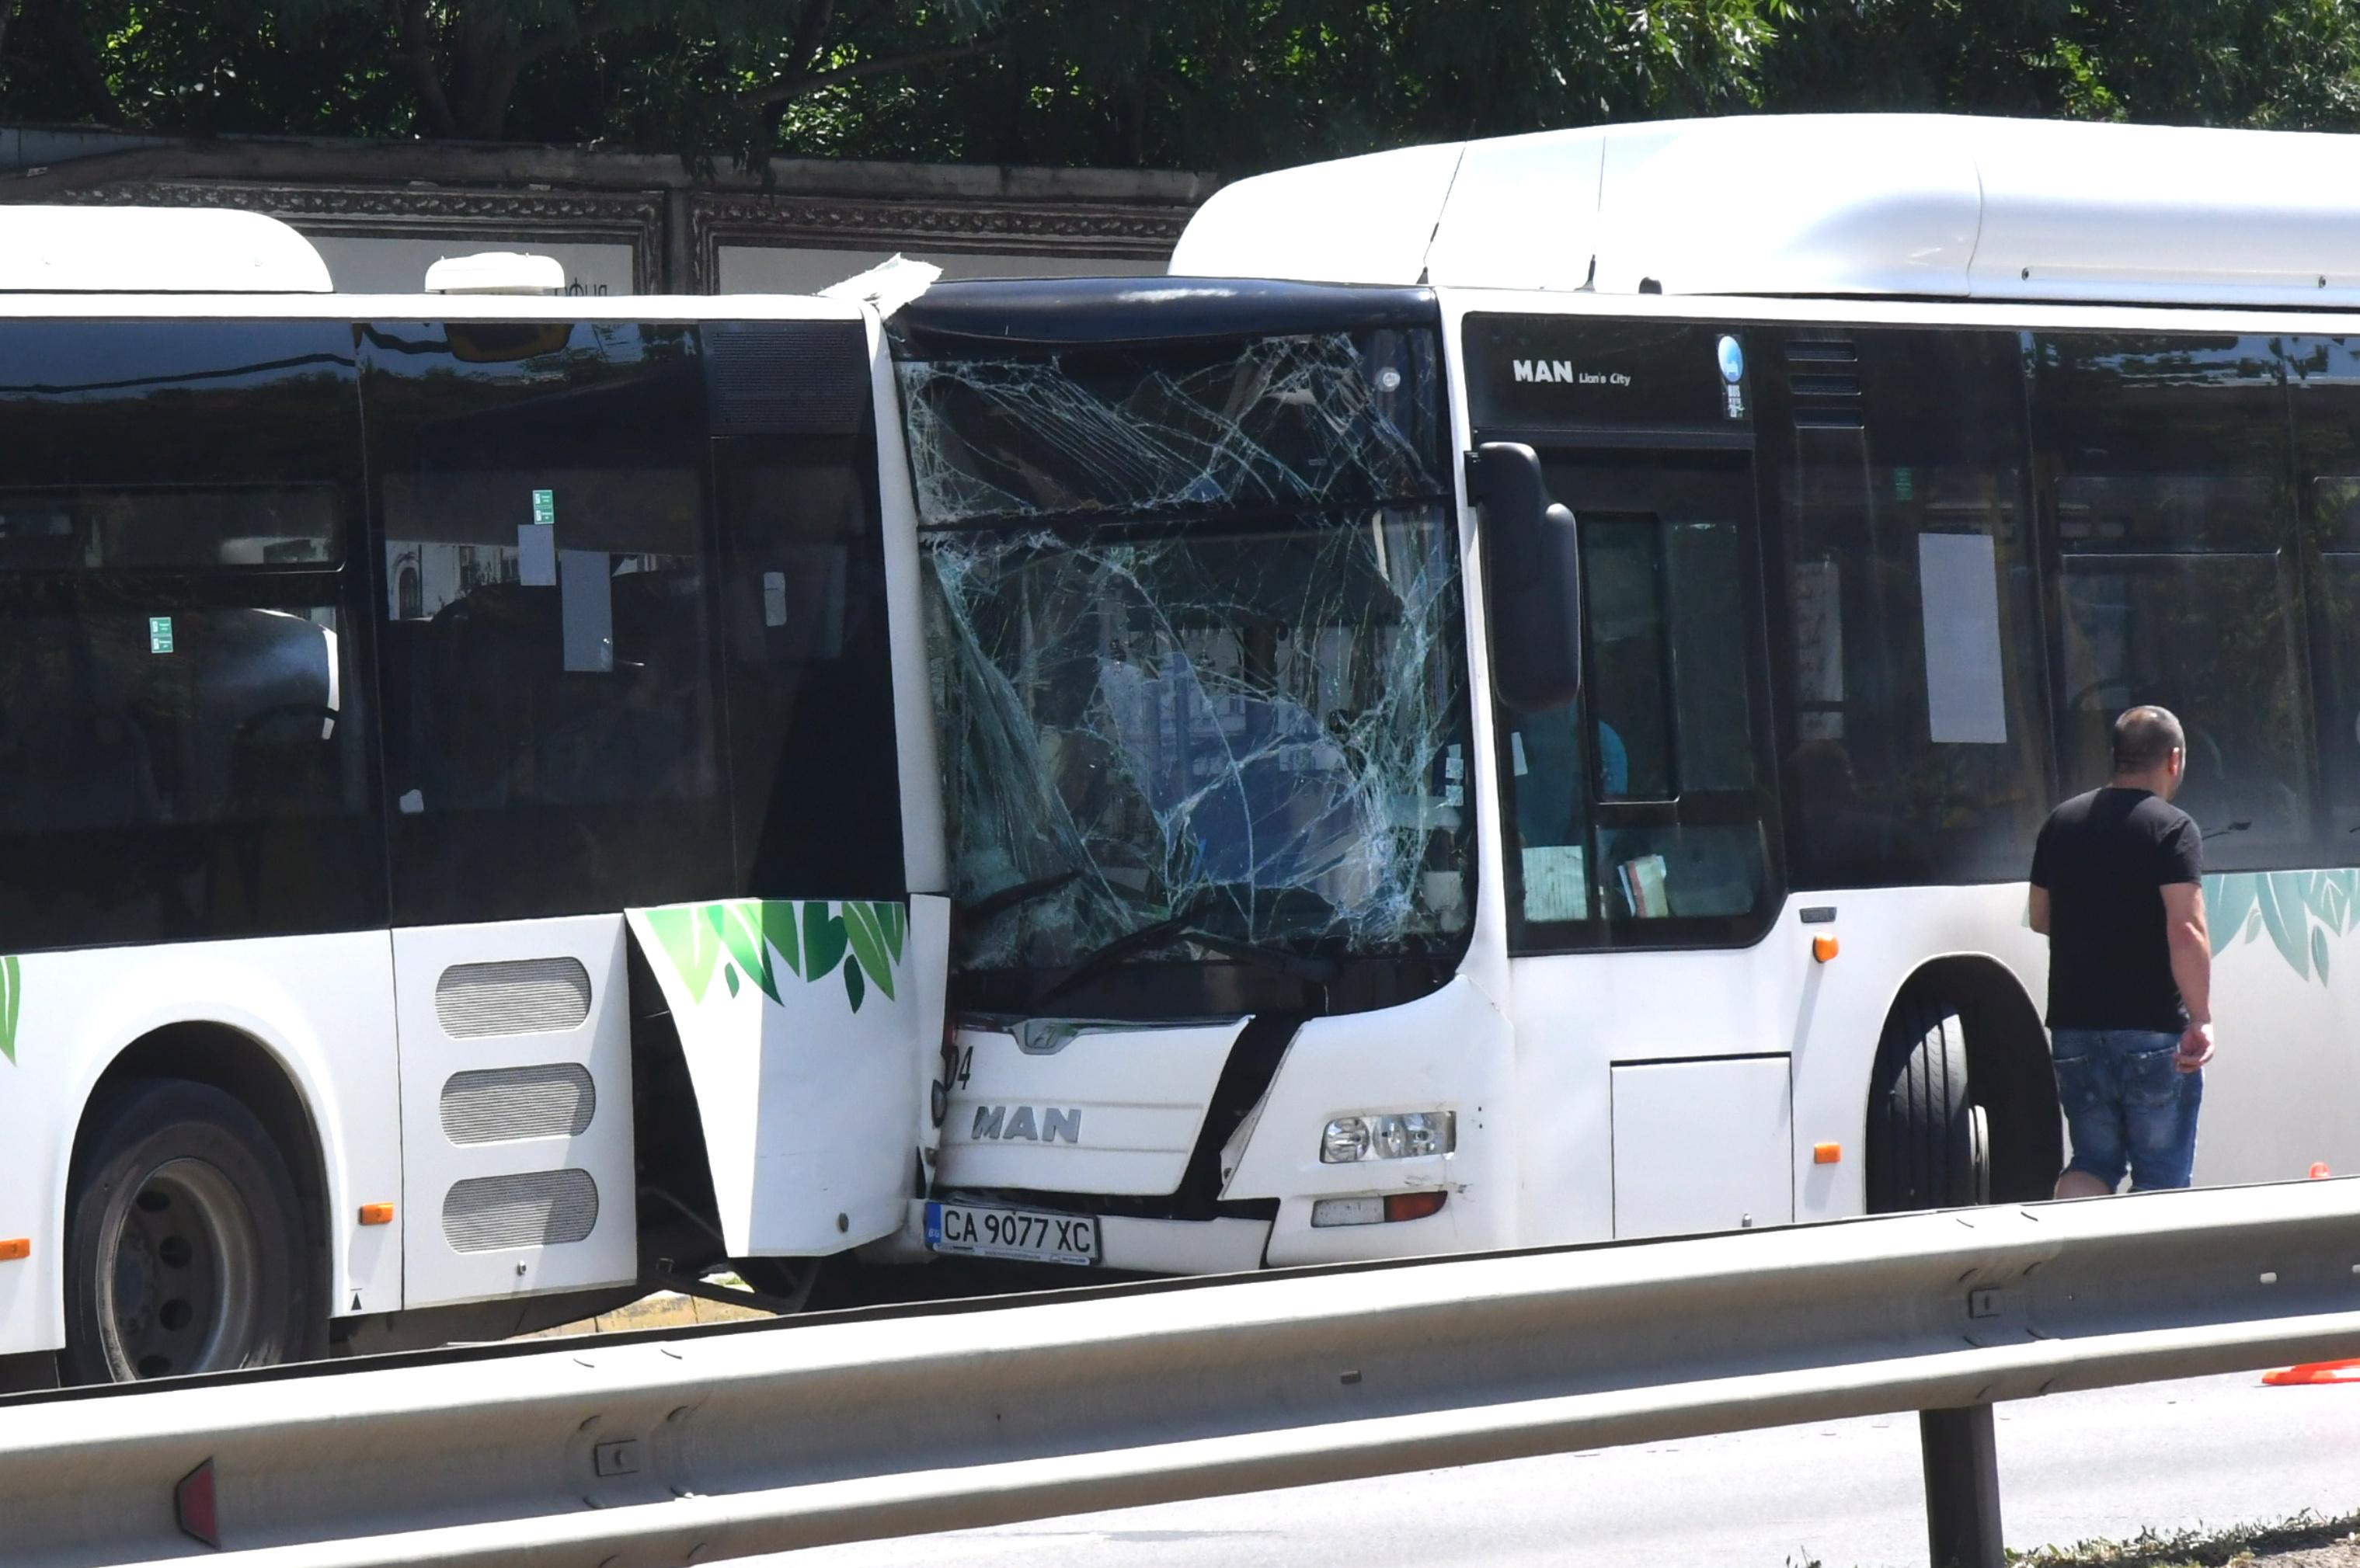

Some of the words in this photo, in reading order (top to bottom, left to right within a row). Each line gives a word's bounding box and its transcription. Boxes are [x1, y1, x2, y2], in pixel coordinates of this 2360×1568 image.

[1512, 359, 1574, 384] MAN
[1579, 372, 1606, 384] Lion's
[1610, 373, 1631, 387] City
[971, 1106, 1081, 1143] MAN
[944, 1210, 979, 1243] CA
[983, 1214, 1049, 1249] 9077
[1056, 1220, 1091, 1253] XC
